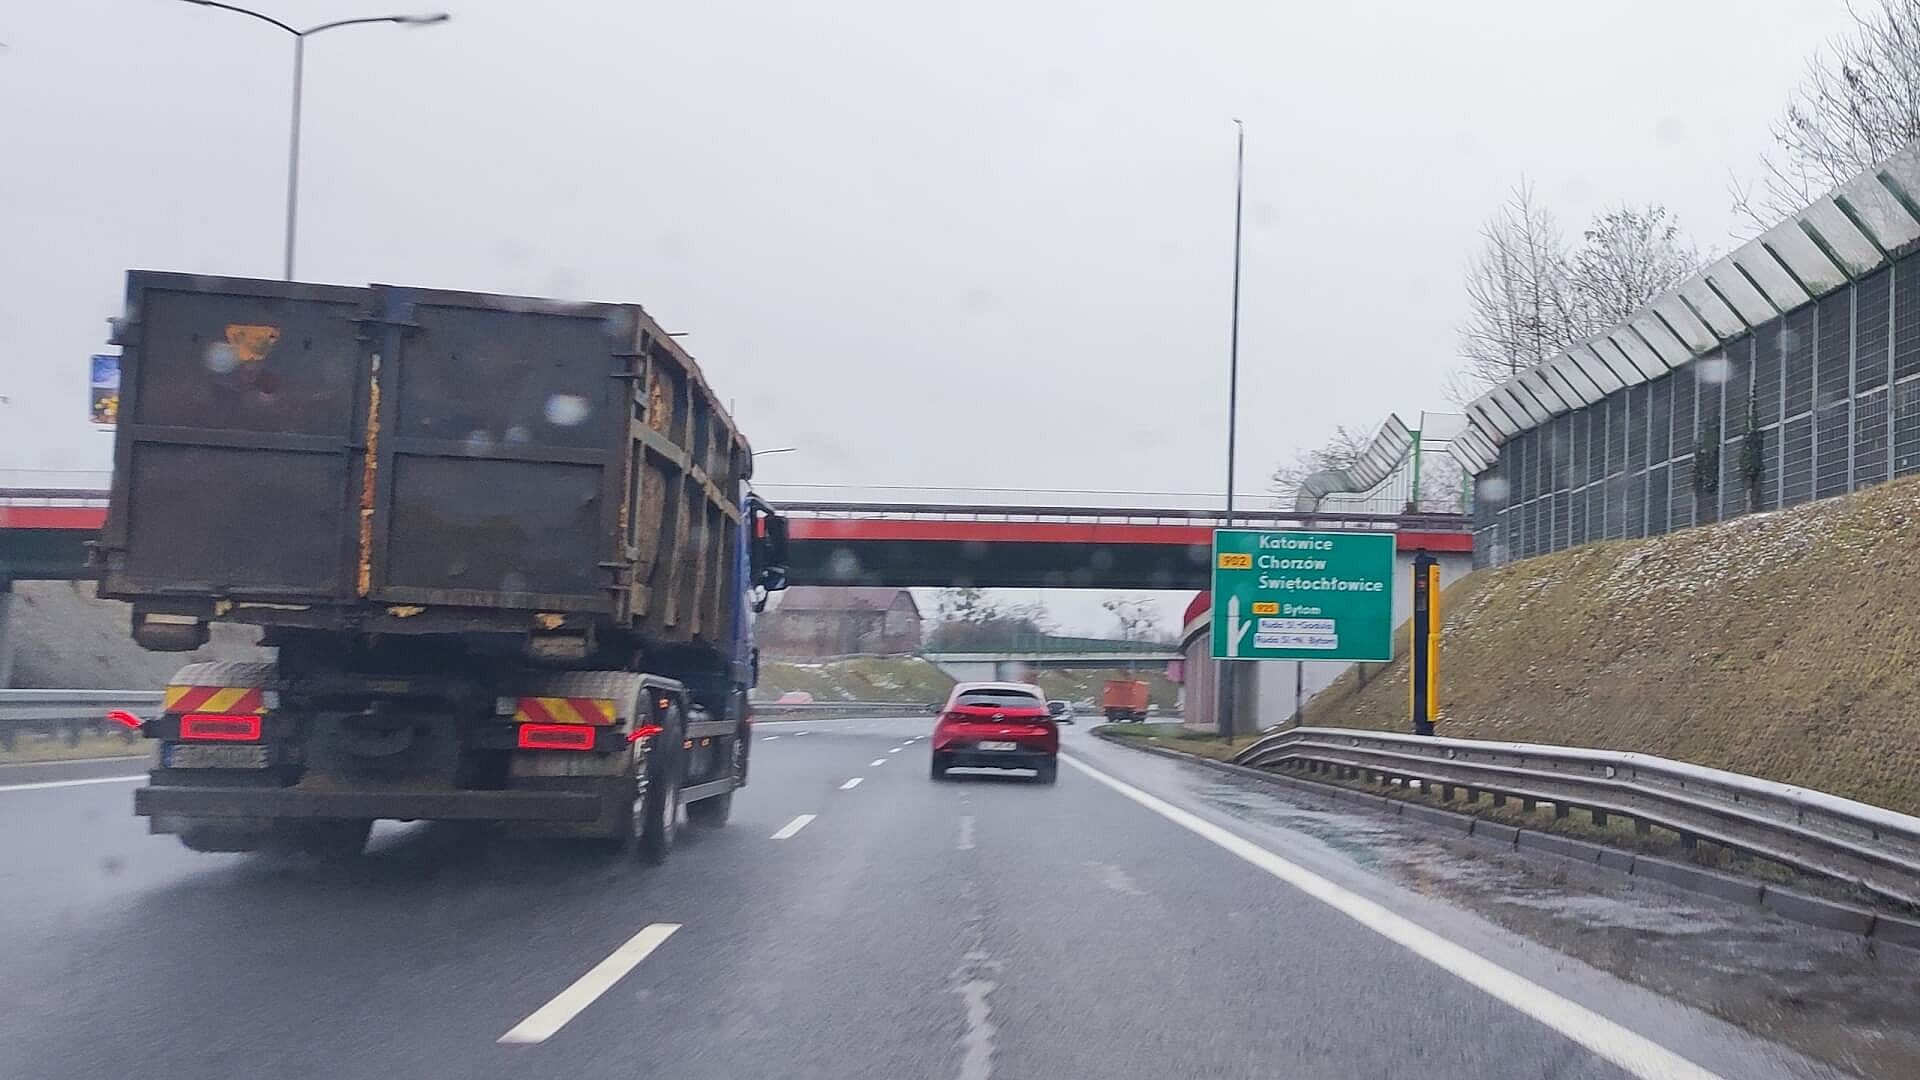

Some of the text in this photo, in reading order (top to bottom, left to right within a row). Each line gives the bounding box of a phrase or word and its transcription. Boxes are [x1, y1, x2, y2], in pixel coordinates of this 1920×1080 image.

[1259, 535, 1333, 551] Katowice
[1223, 556, 1247, 567] 902
[1258, 555, 1326, 570] Chorzów
[1258, 572, 1384, 593] Świętochłowice
[1283, 603, 1321, 617] Bytom
